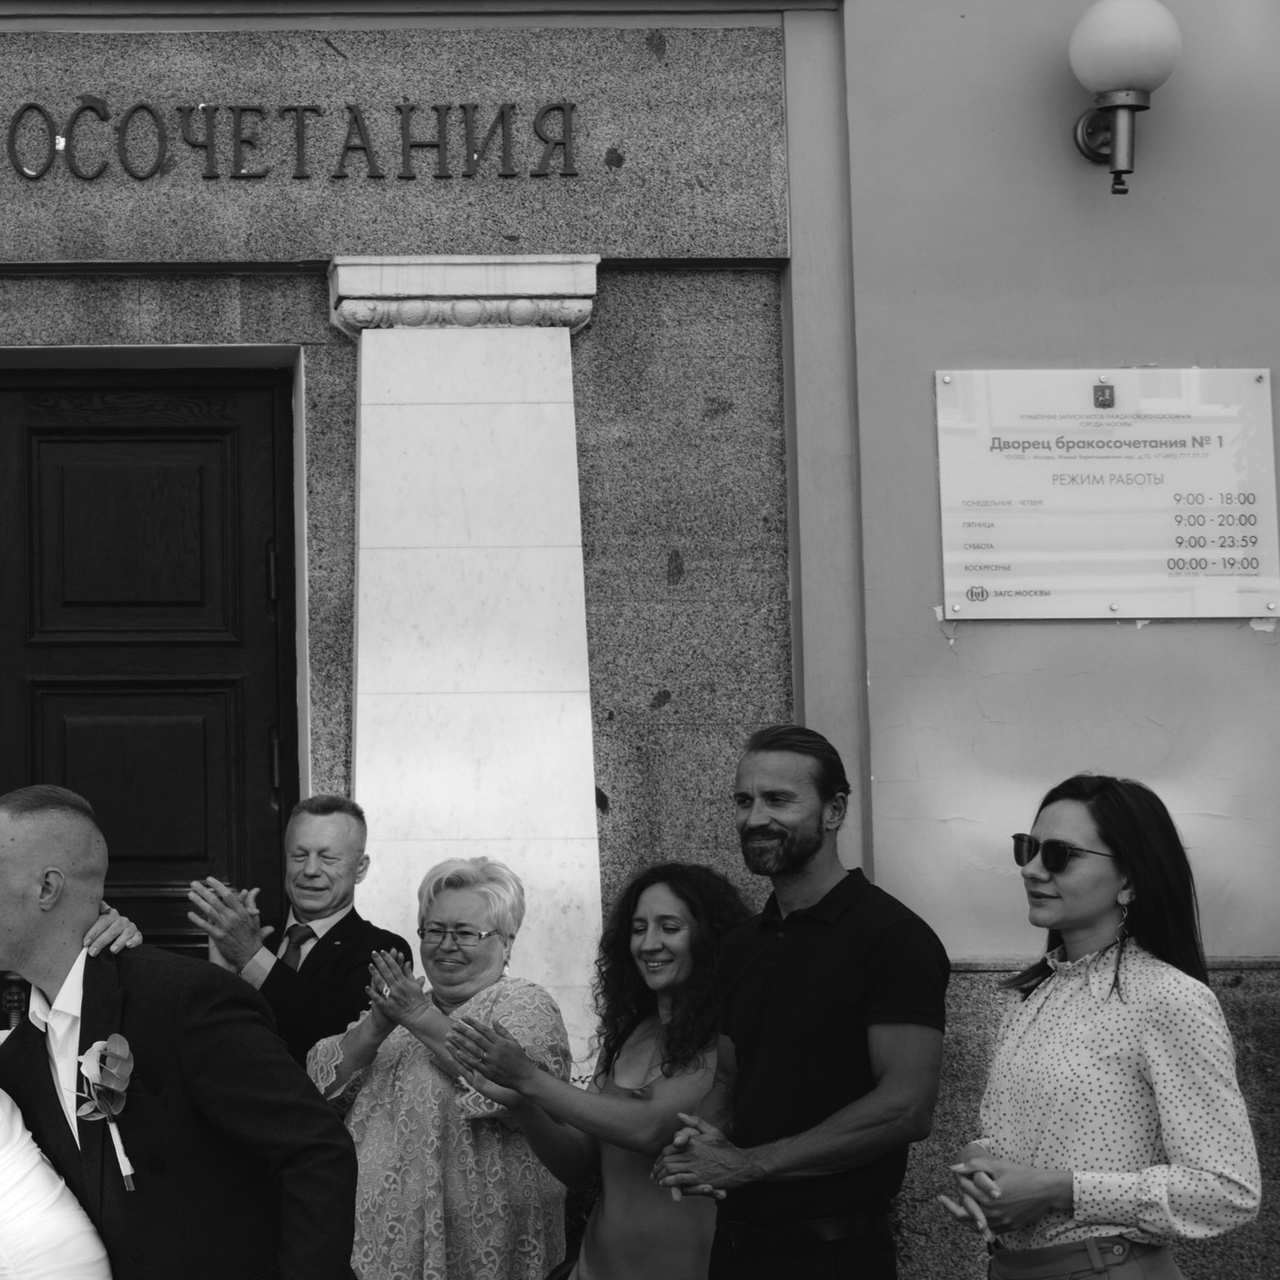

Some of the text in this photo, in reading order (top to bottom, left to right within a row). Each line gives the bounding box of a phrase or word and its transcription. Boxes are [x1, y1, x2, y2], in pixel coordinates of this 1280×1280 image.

[990, 437, 1052, 453] Дворец
[1055, 435, 1187, 453] бракосочетания
[1217, 435, 1224, 448] 1
[1052, 473, 1164, 486] РЕЖИМ РАБОТЫ
[1173, 493, 1205, 505] 9:00
[1219, 493, 1256, 505] 18:00
[1174, 514, 1206, 527] 9:00
[1217, 514, 1257, 527] 20:00
[1175, 536, 1207, 548] 9:00
[1218, 535, 1258, 548] 23:59
[1167, 558, 1208, 570] 00:00
[1221, 557, 1260, 570] 19:00
